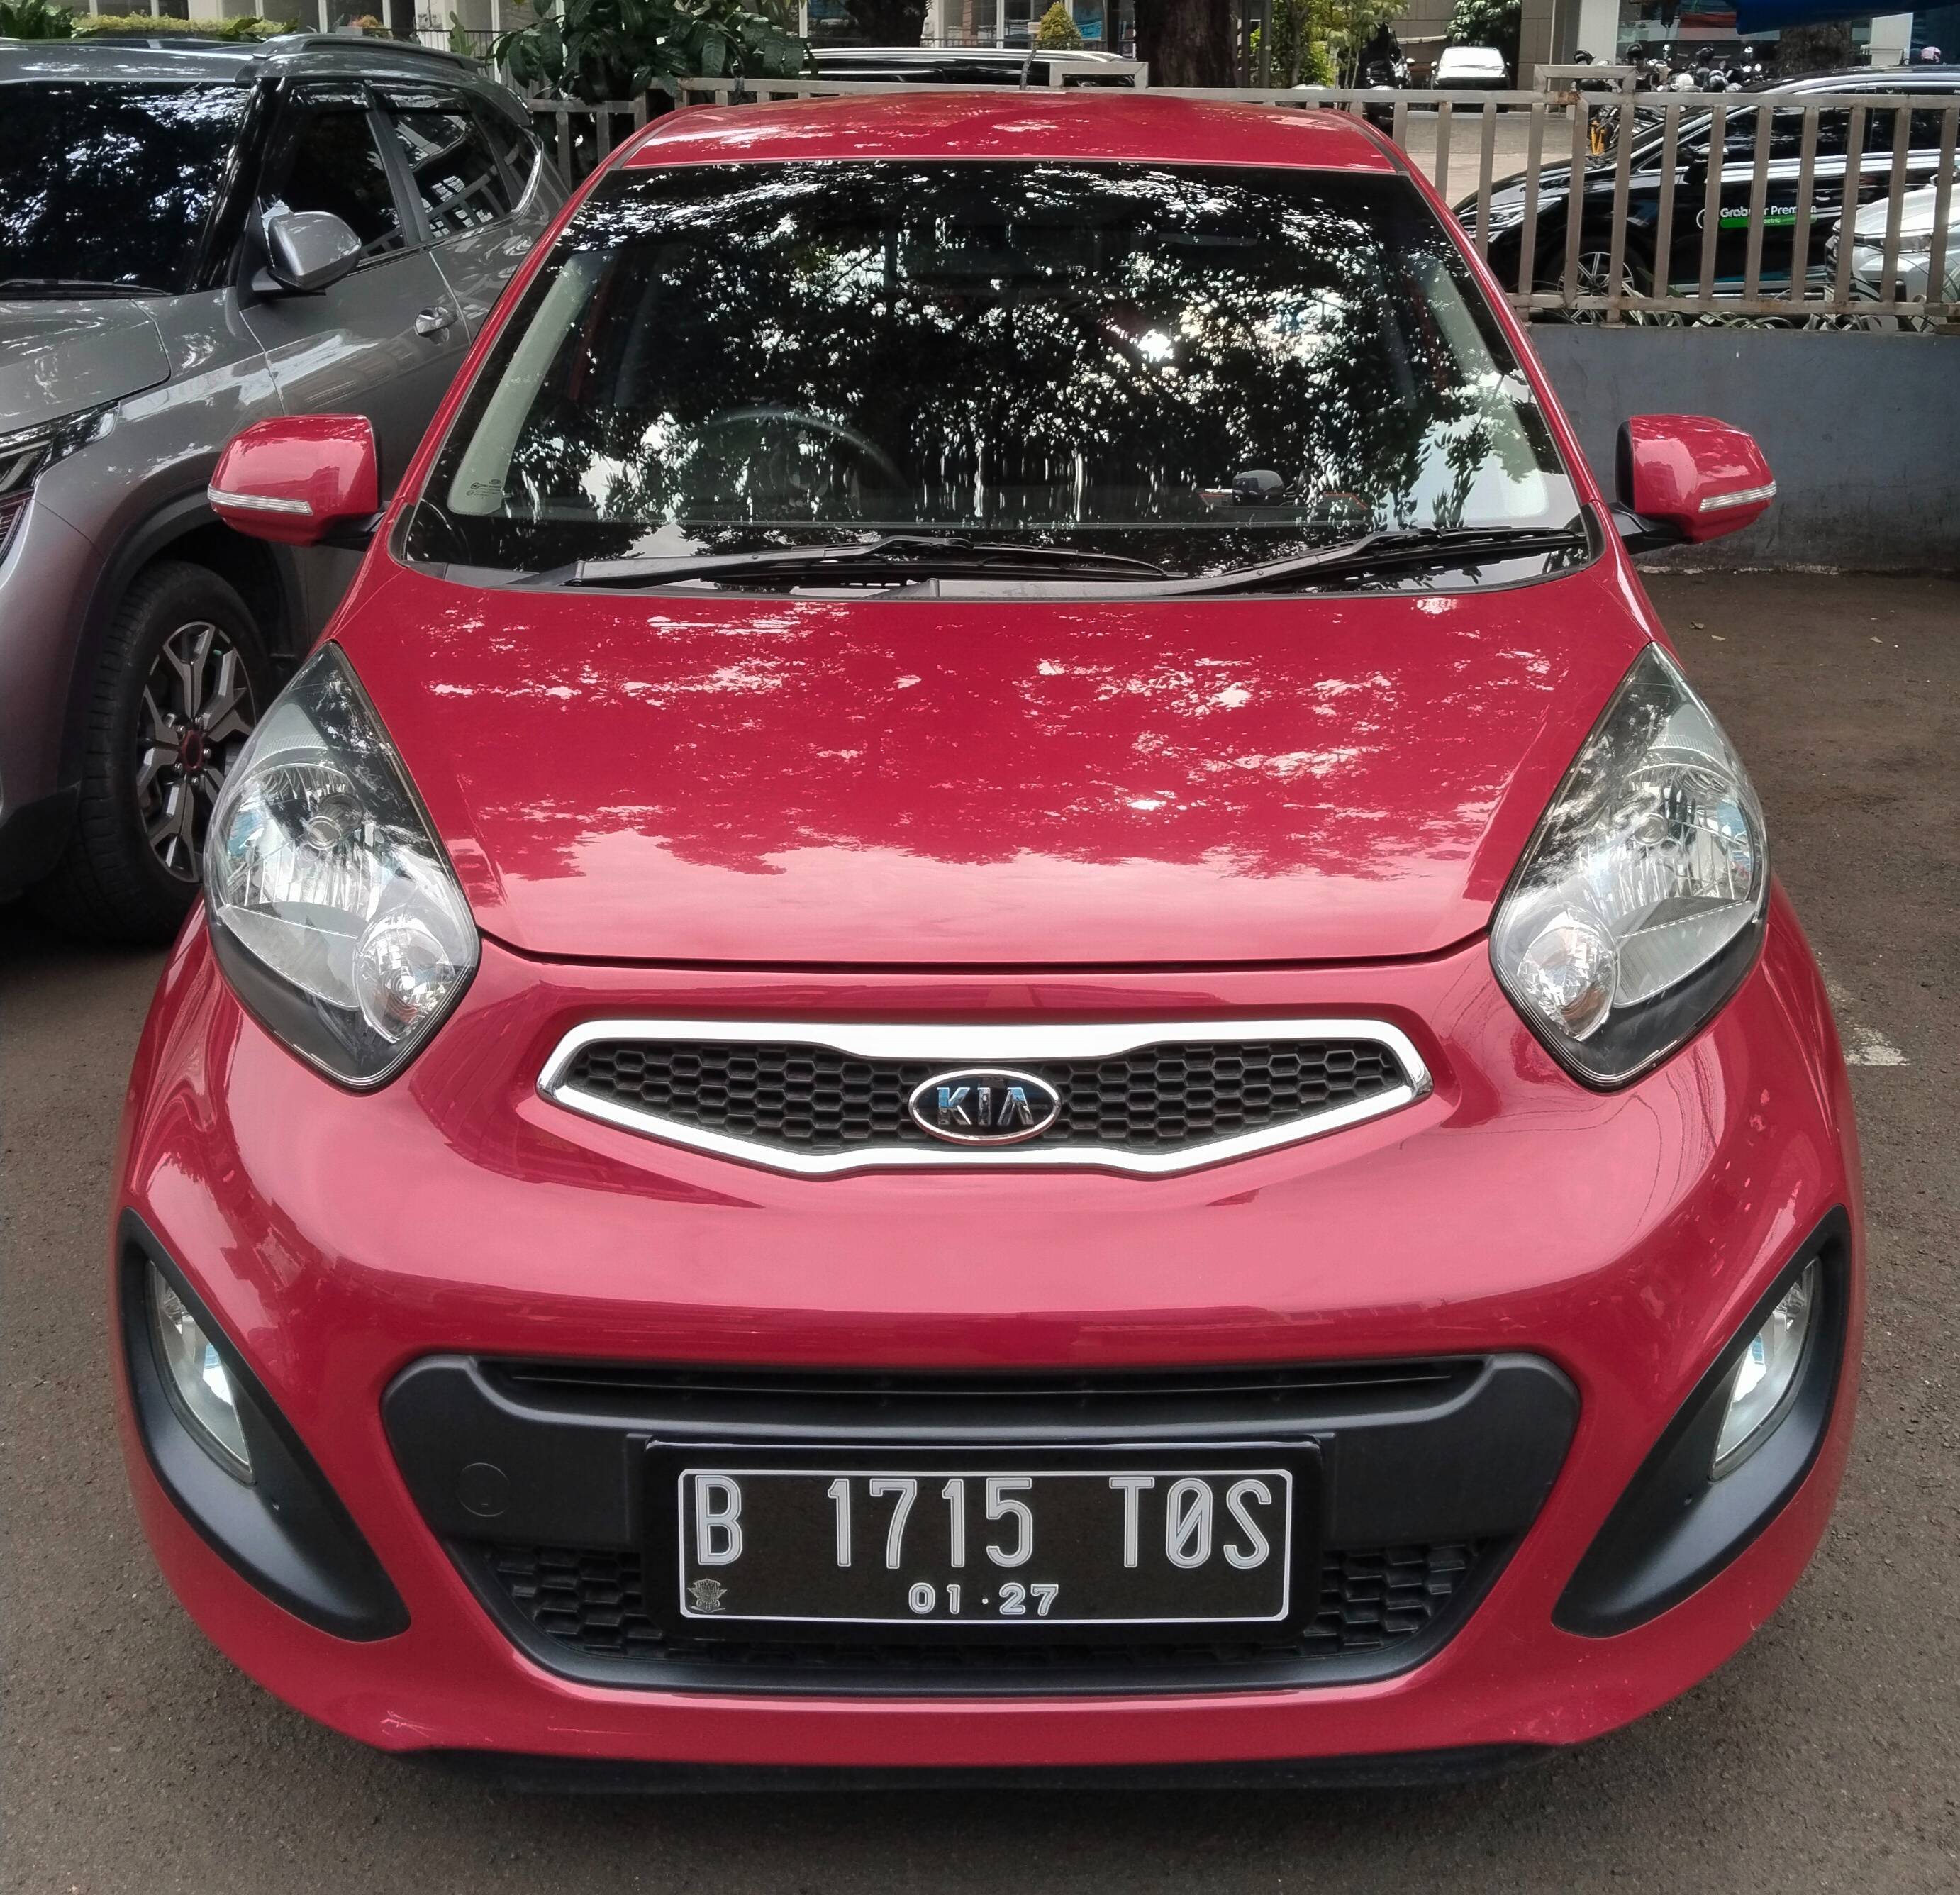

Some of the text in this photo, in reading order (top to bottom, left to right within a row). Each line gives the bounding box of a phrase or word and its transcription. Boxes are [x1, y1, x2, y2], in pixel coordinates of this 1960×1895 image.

[1720, 205, 1817, 218] Grabr Premm
[936, 1087, 1035, 1126] KIA
[695, 1474, 742, 1565] B
[828, 1477, 1032, 1569] 1715
